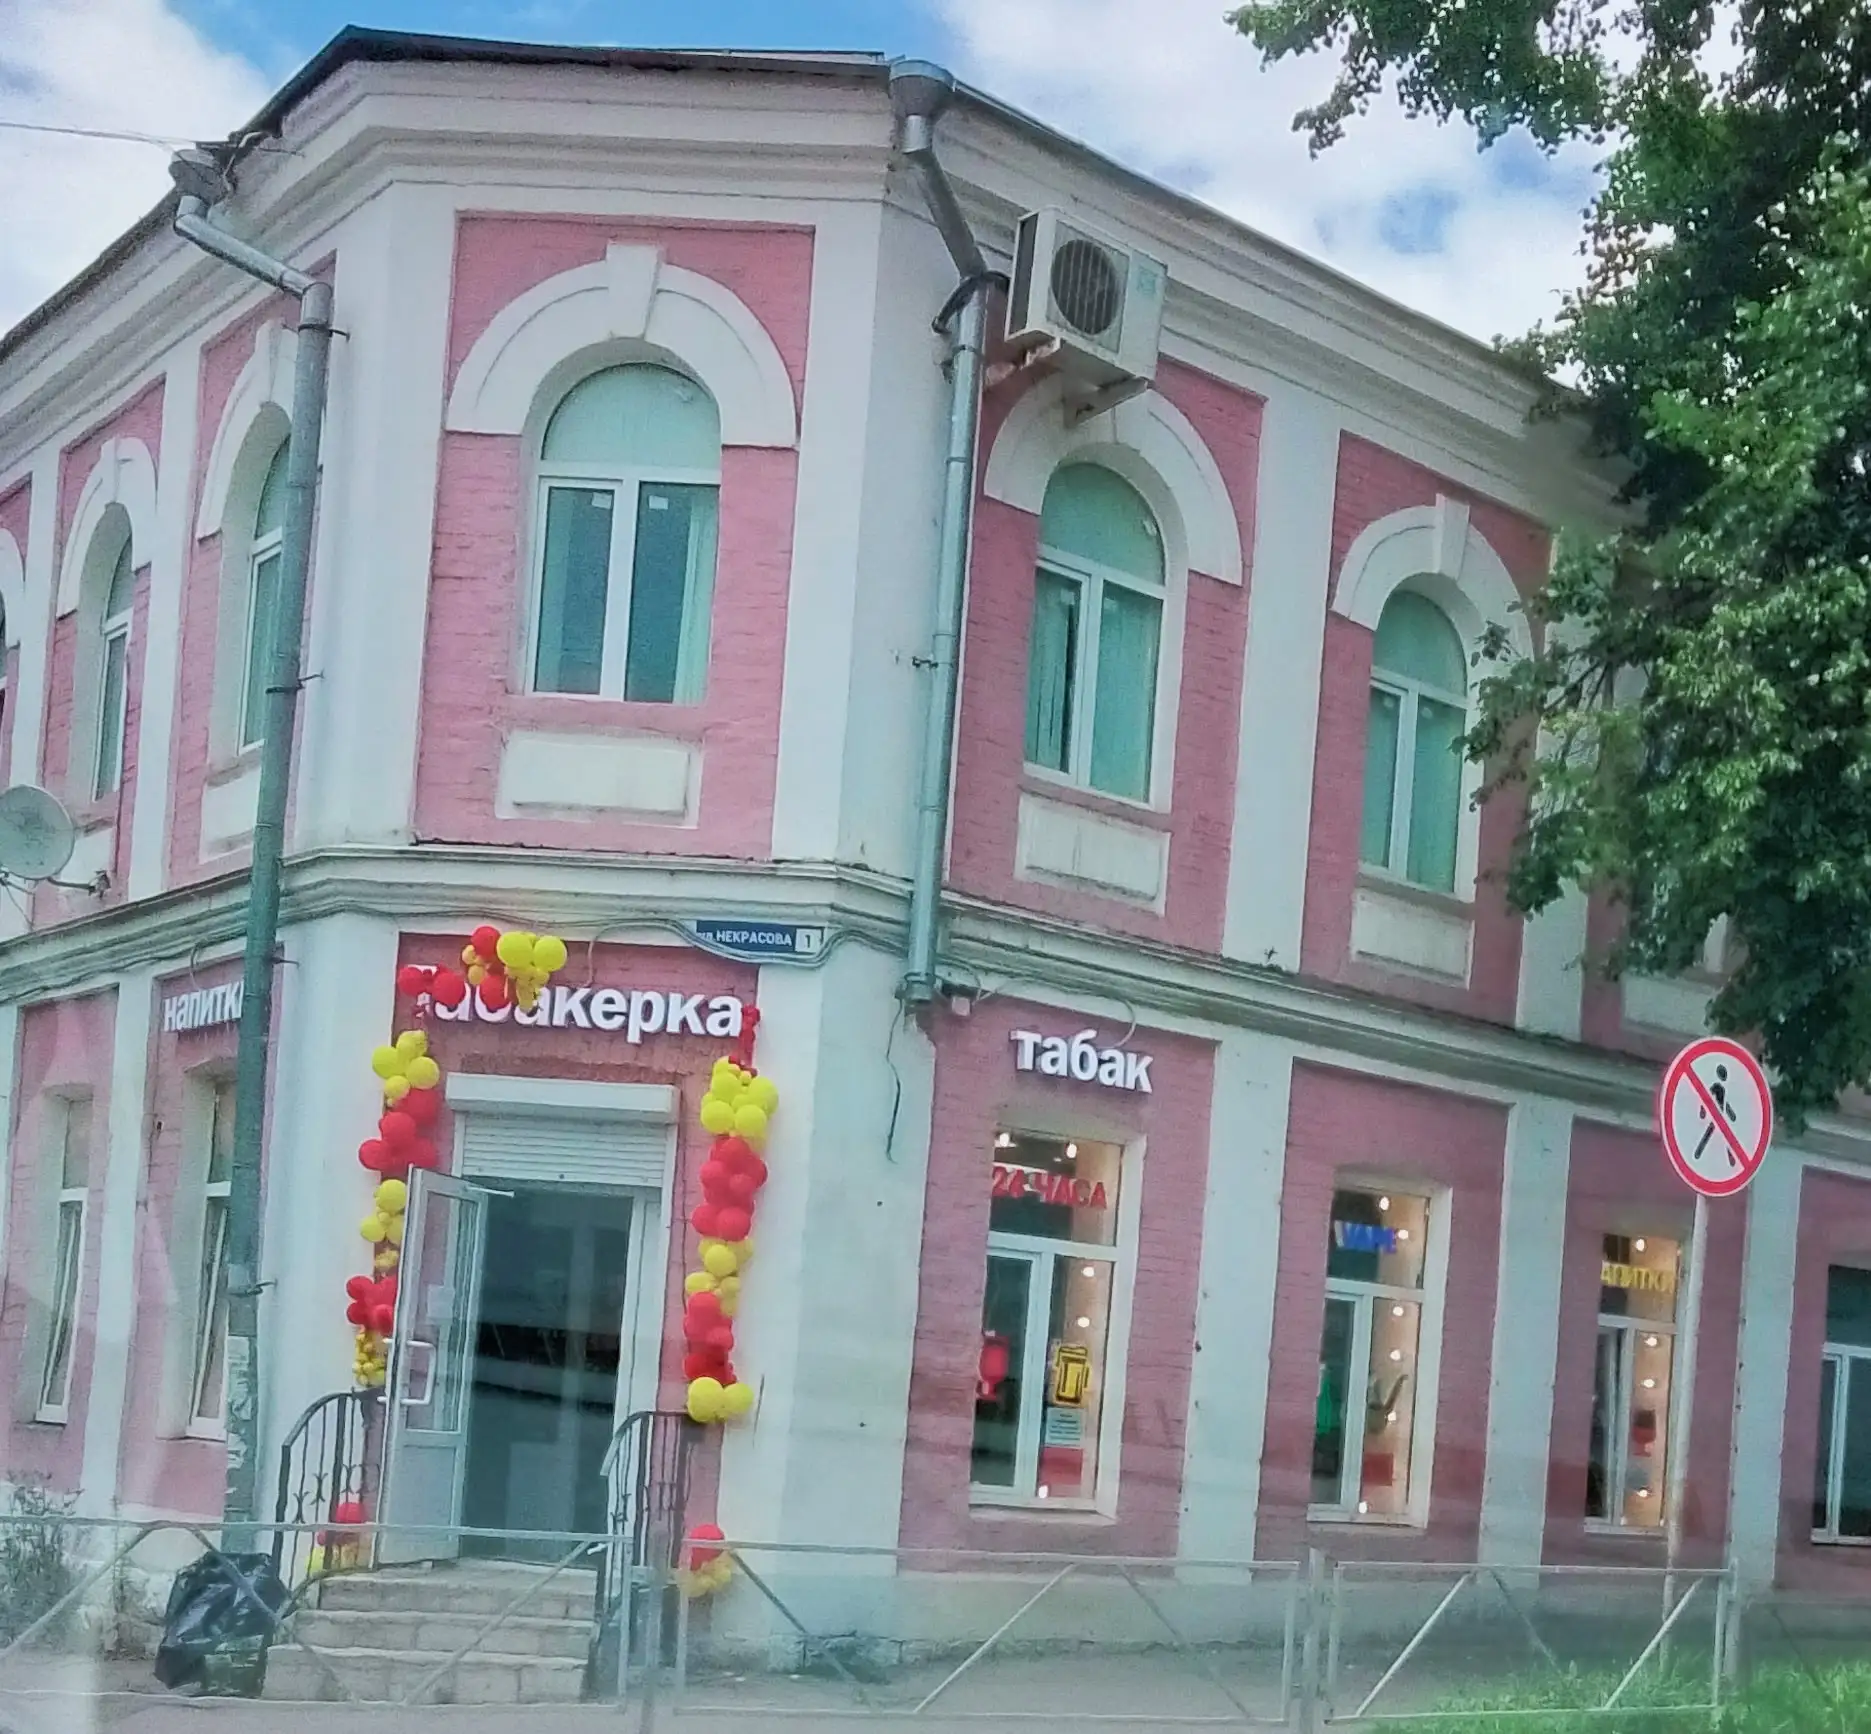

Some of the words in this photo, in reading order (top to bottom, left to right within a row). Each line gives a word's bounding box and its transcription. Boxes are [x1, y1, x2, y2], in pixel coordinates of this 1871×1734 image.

[717, 930, 792, 946] НЕКРАСОВА
[803, 933, 811, 949] 1
[1009, 1029, 1154, 1094] табак
